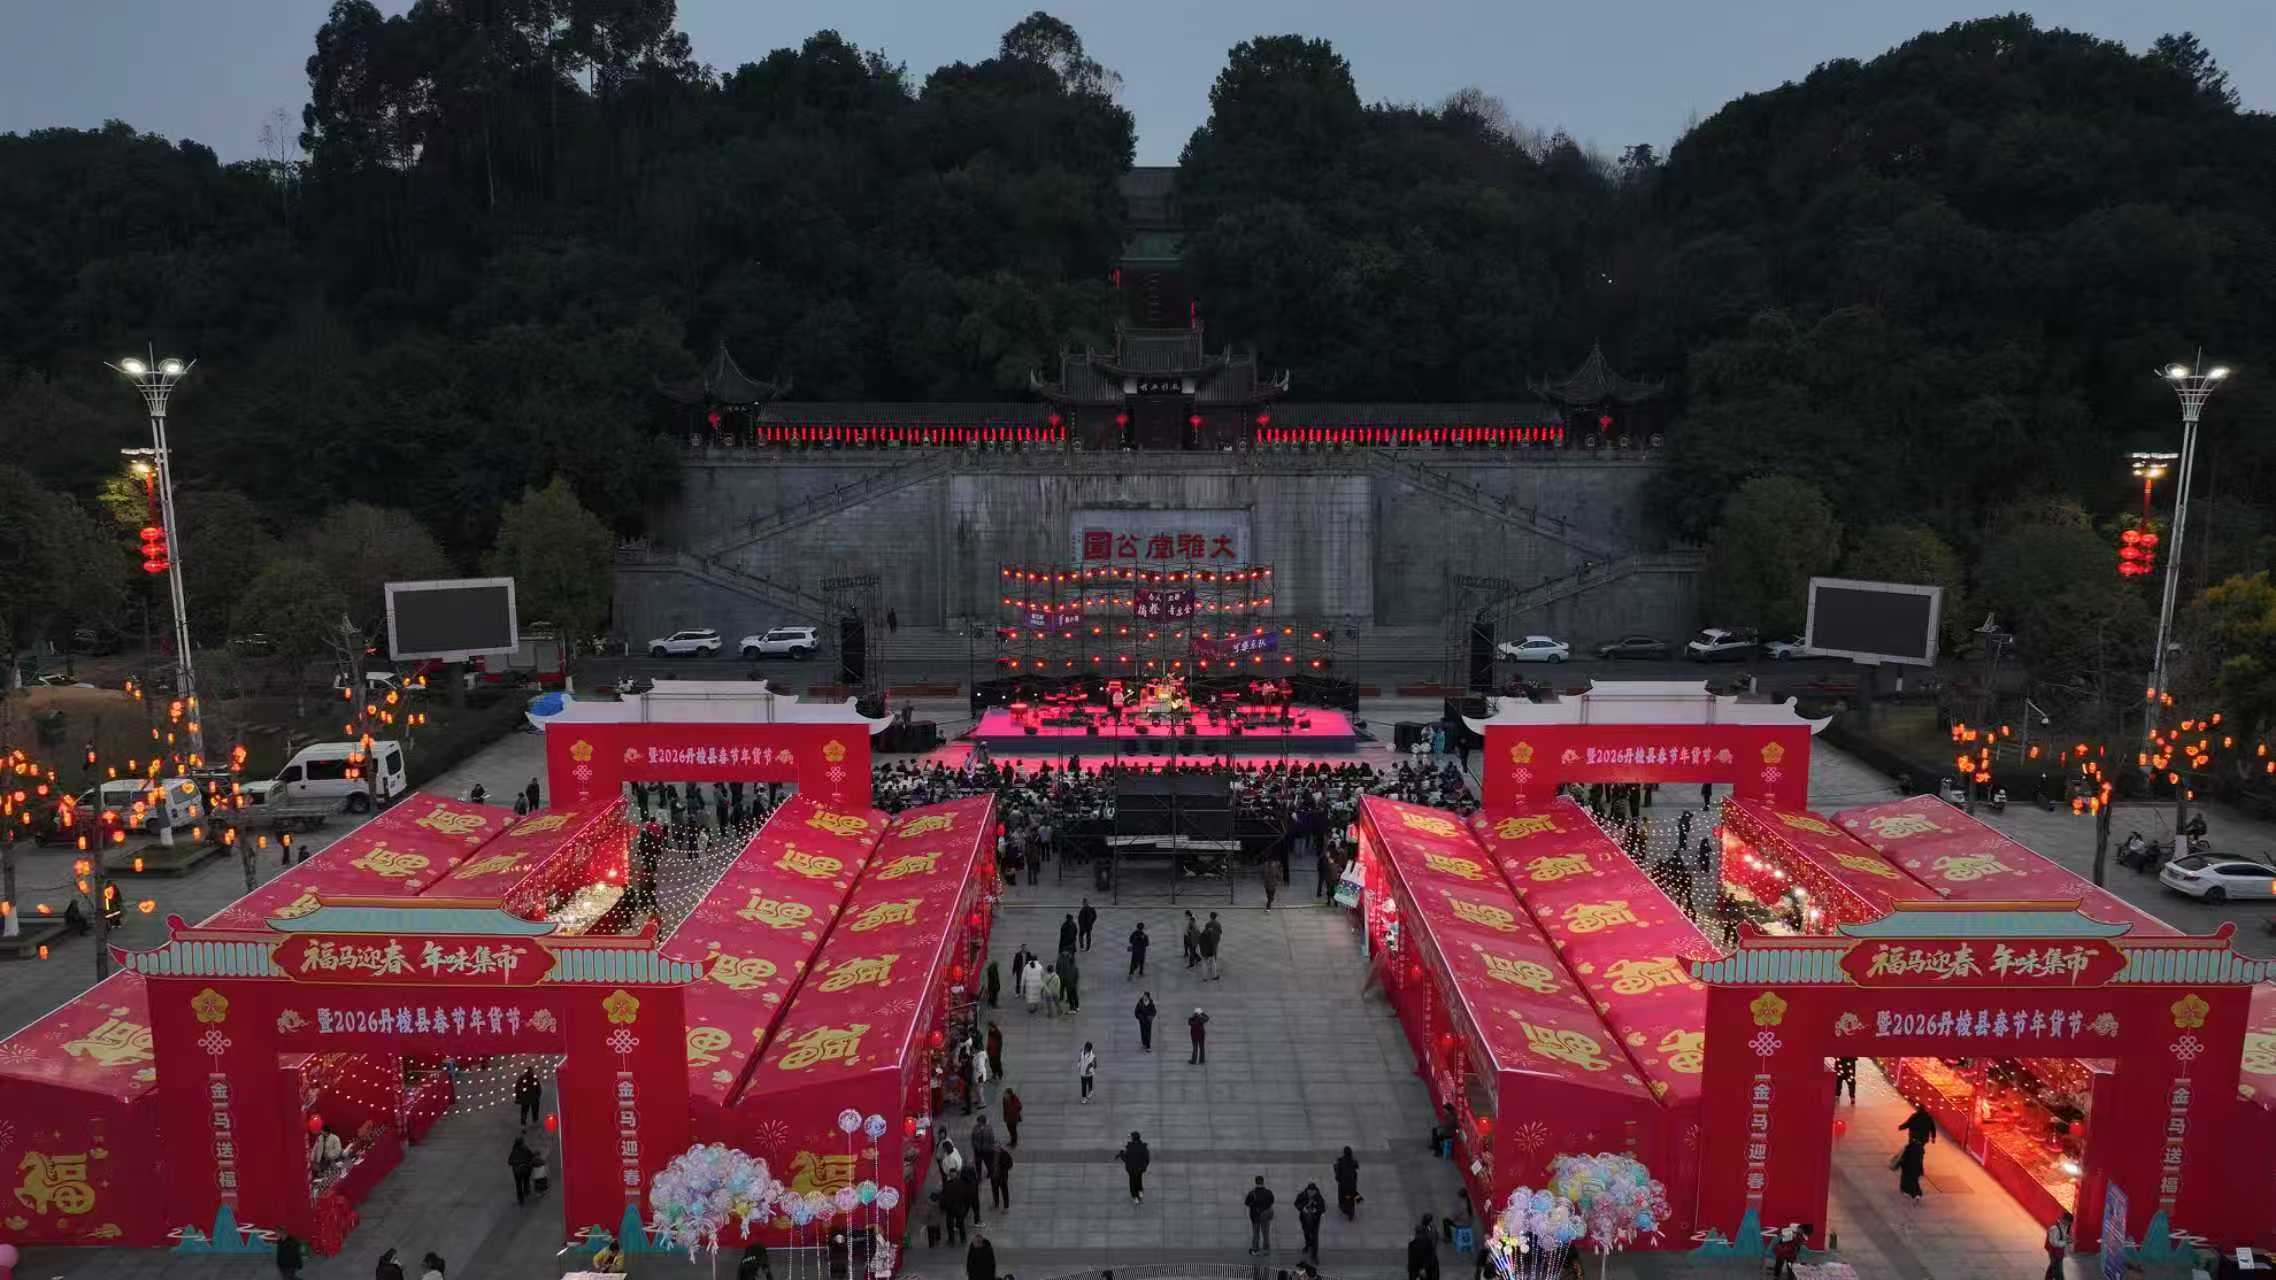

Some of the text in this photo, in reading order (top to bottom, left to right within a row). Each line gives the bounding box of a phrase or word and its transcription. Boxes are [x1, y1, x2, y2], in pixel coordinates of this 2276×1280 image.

[300, 938, 528, 984] 福马迎春 年味集市
[1866, 942, 2100, 987] 福马迎春 年味集市
[316, 1006, 522, 1037] 暨2026丹棱县春节年货节
[1874, 1009, 2085, 1040] 暨2026丹棱县春节年货节
[210, 1082, 237, 1188] 金马送福
[617, 1080, 641, 1186] 金马迎春
[1746, 1083, 1772, 1189] 金马迎春
[2160, 1087, 2191, 1194] 金马送福
